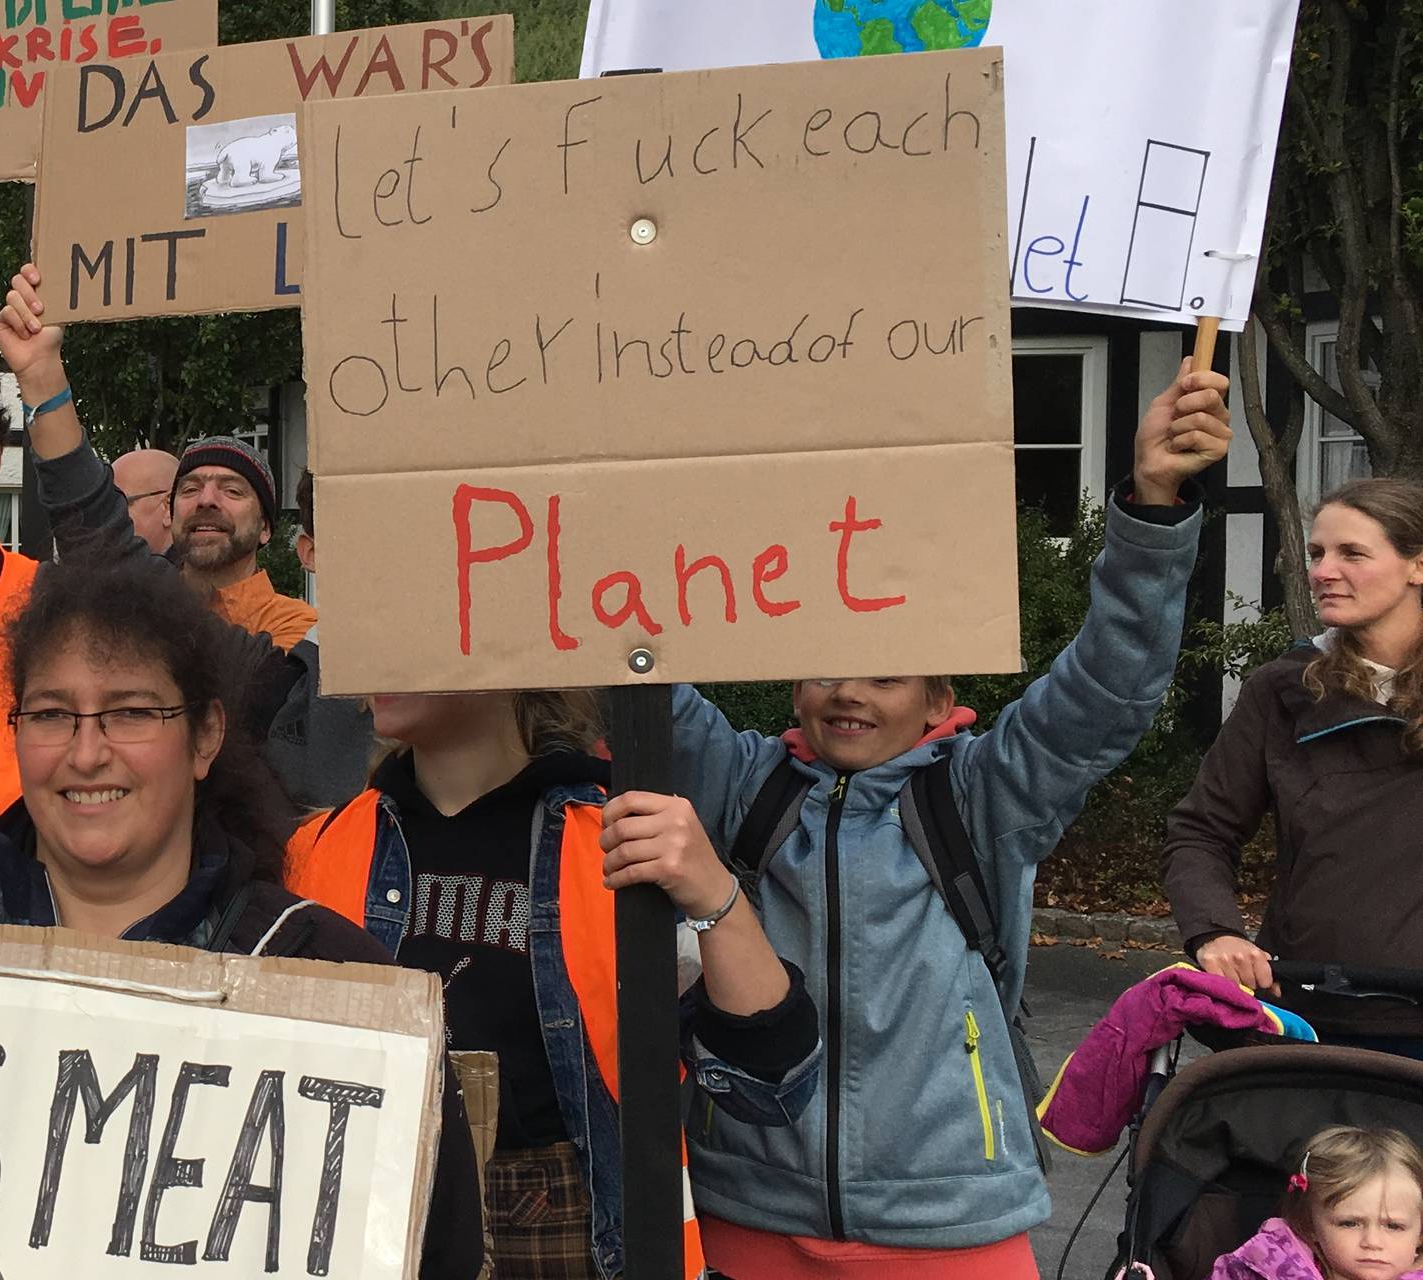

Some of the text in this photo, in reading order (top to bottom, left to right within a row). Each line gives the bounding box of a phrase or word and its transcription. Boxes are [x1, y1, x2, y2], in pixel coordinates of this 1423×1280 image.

[77, 20, 495, 133] DAS WAR'S
[802, 71, 981, 158] each
[69, 228, 207, 310] MIT
[329, 293, 574, 416] other
[887, 314, 985, 362] our
[452, 482, 907, 656] Planet
[29, 1048, 385, 1276] MEAT
